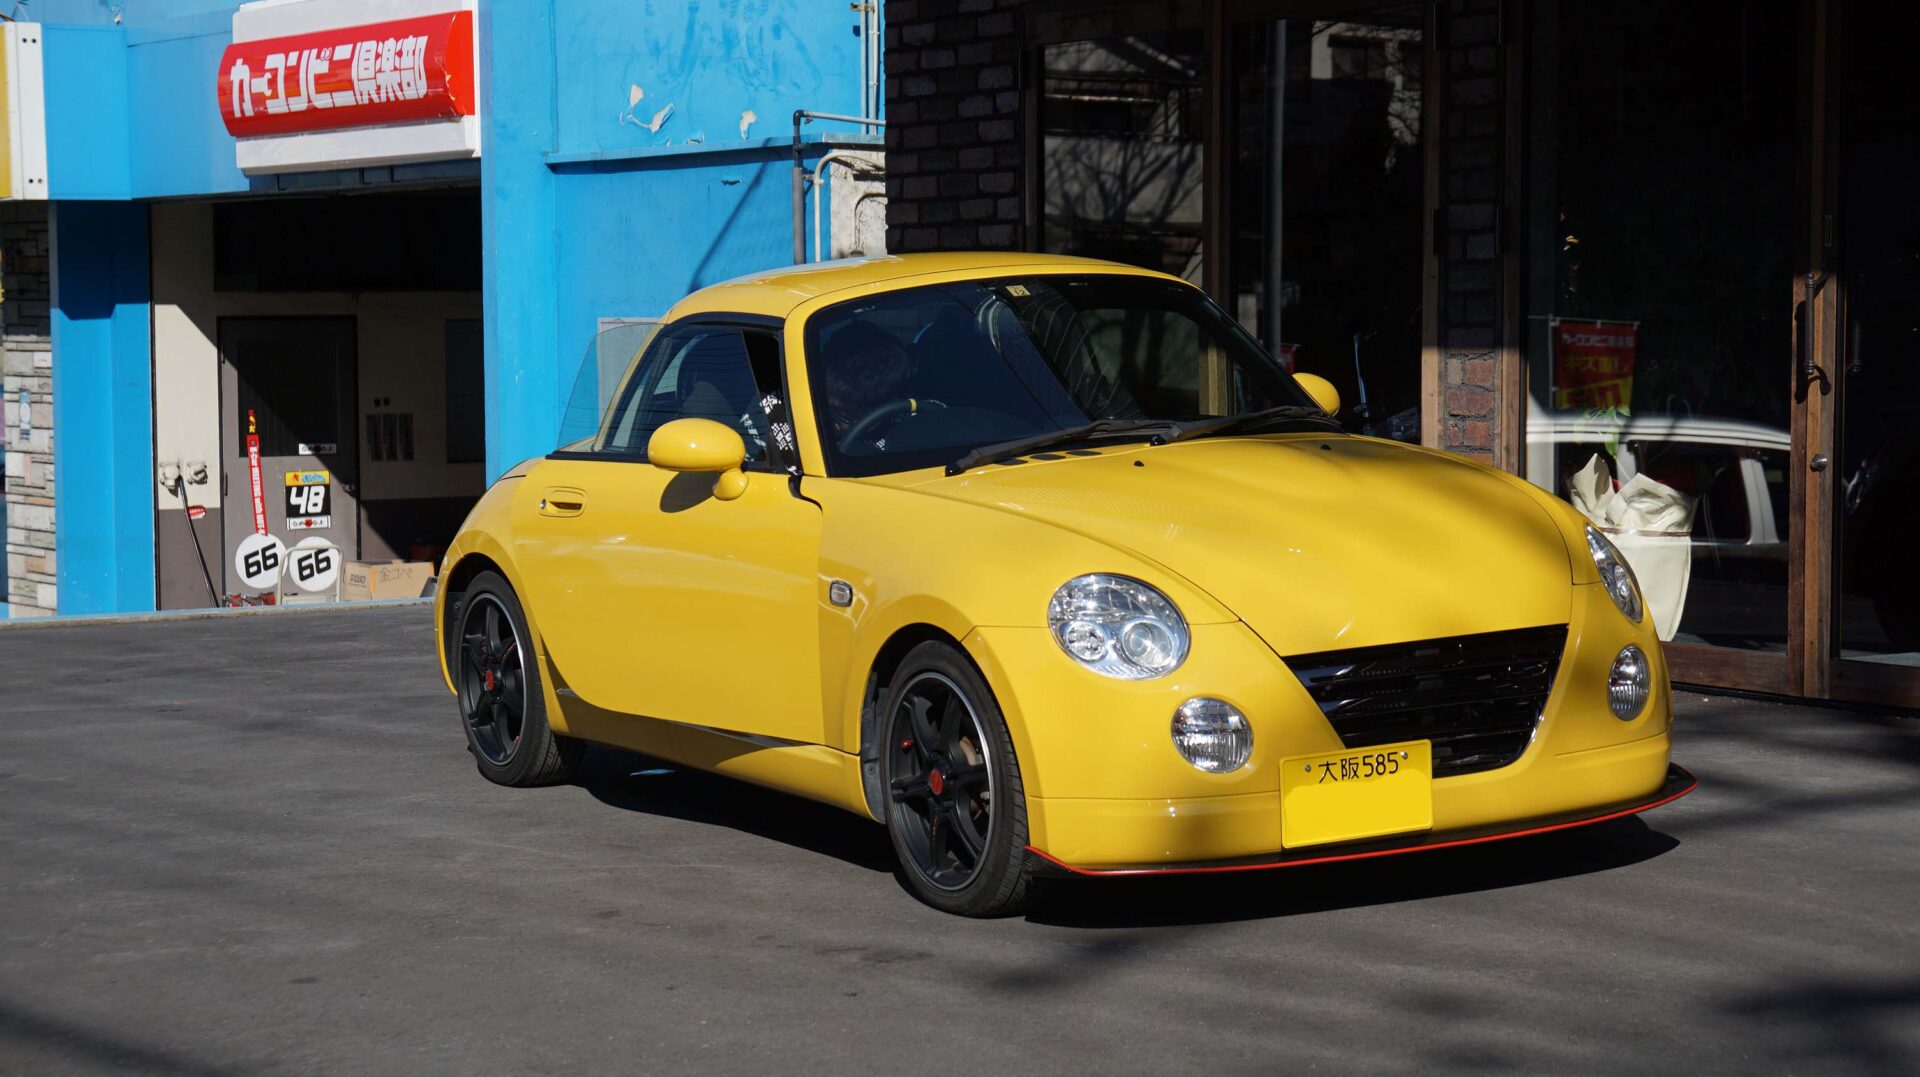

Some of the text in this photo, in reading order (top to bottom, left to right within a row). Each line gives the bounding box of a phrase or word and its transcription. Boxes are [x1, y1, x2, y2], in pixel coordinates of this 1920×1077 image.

[230, 35, 428, 118] カーコンビニ倶楽部
[290, 486, 325, 514] 48
[244, 542, 279, 579] 66
[297, 548, 331, 582] 66
